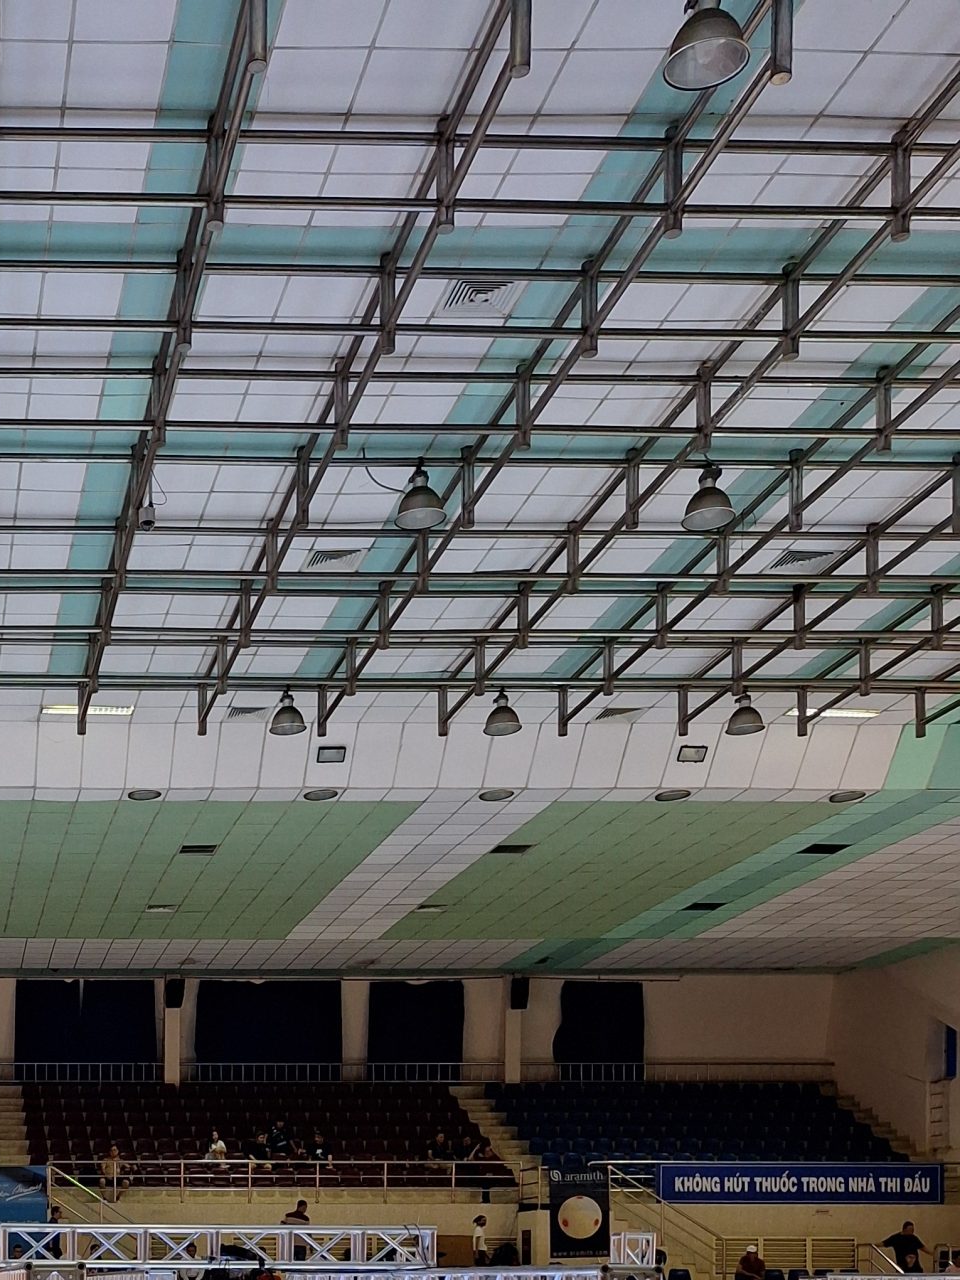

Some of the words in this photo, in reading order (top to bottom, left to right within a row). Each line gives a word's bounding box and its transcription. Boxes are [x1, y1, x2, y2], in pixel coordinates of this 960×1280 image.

[674, 1173, 720, 1192] KHÔNG
[724, 1172, 750, 1192] HÚT
[754, 1170, 797, 1192] THUỐC
[801, 1177, 845, 1193] TRONG
[848, 1173, 876, 1193] NHÀ
[878, 1177, 900, 1193] THI
[904, 1171, 930, 1193] ĐẤU
